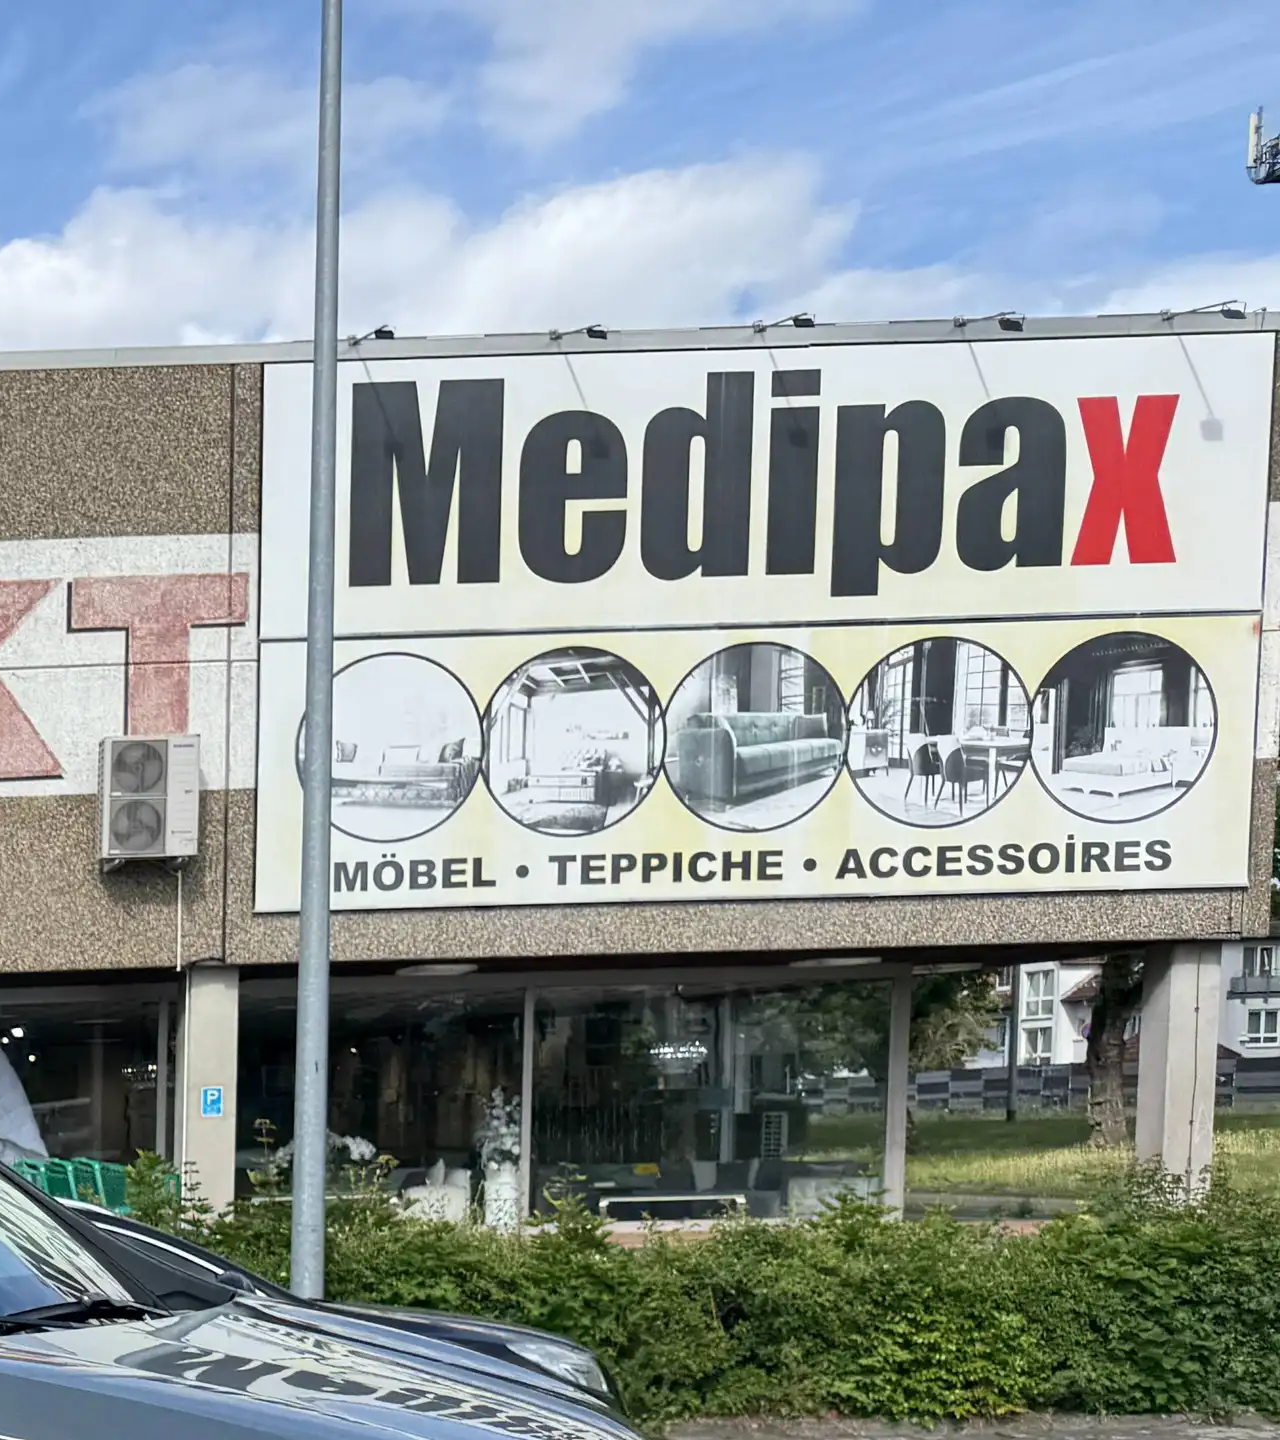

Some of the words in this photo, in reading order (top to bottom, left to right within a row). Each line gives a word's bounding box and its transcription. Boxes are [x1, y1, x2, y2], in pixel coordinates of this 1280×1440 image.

[348, 369, 1179, 597] Medipax
[332, 852, 497, 893] MÖBEL
[548, 850, 784, 886] TEPPICHE
